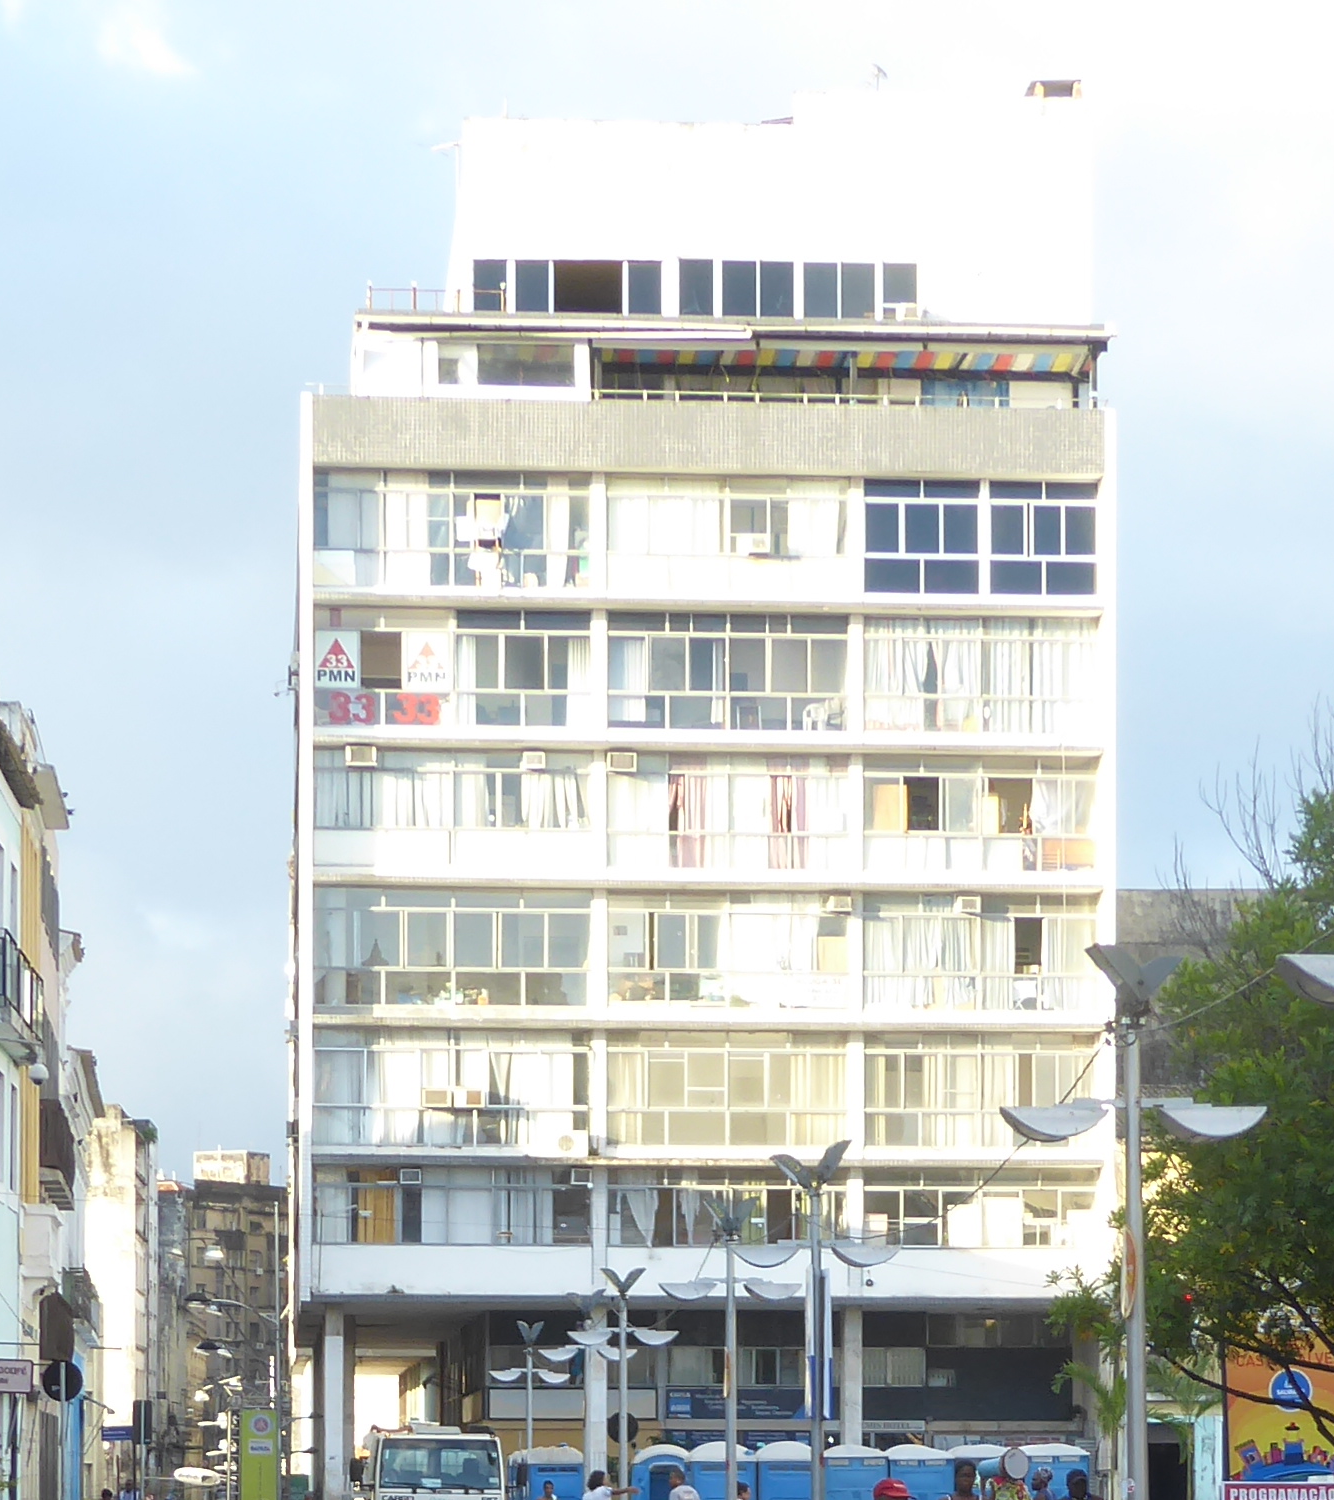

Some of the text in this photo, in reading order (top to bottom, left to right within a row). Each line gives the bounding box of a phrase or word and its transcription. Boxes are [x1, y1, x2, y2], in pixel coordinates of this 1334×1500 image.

[326, 654, 349, 668] 33
[317, 669, 356, 682] PMN
[328, 691, 441, 725] 33 33
